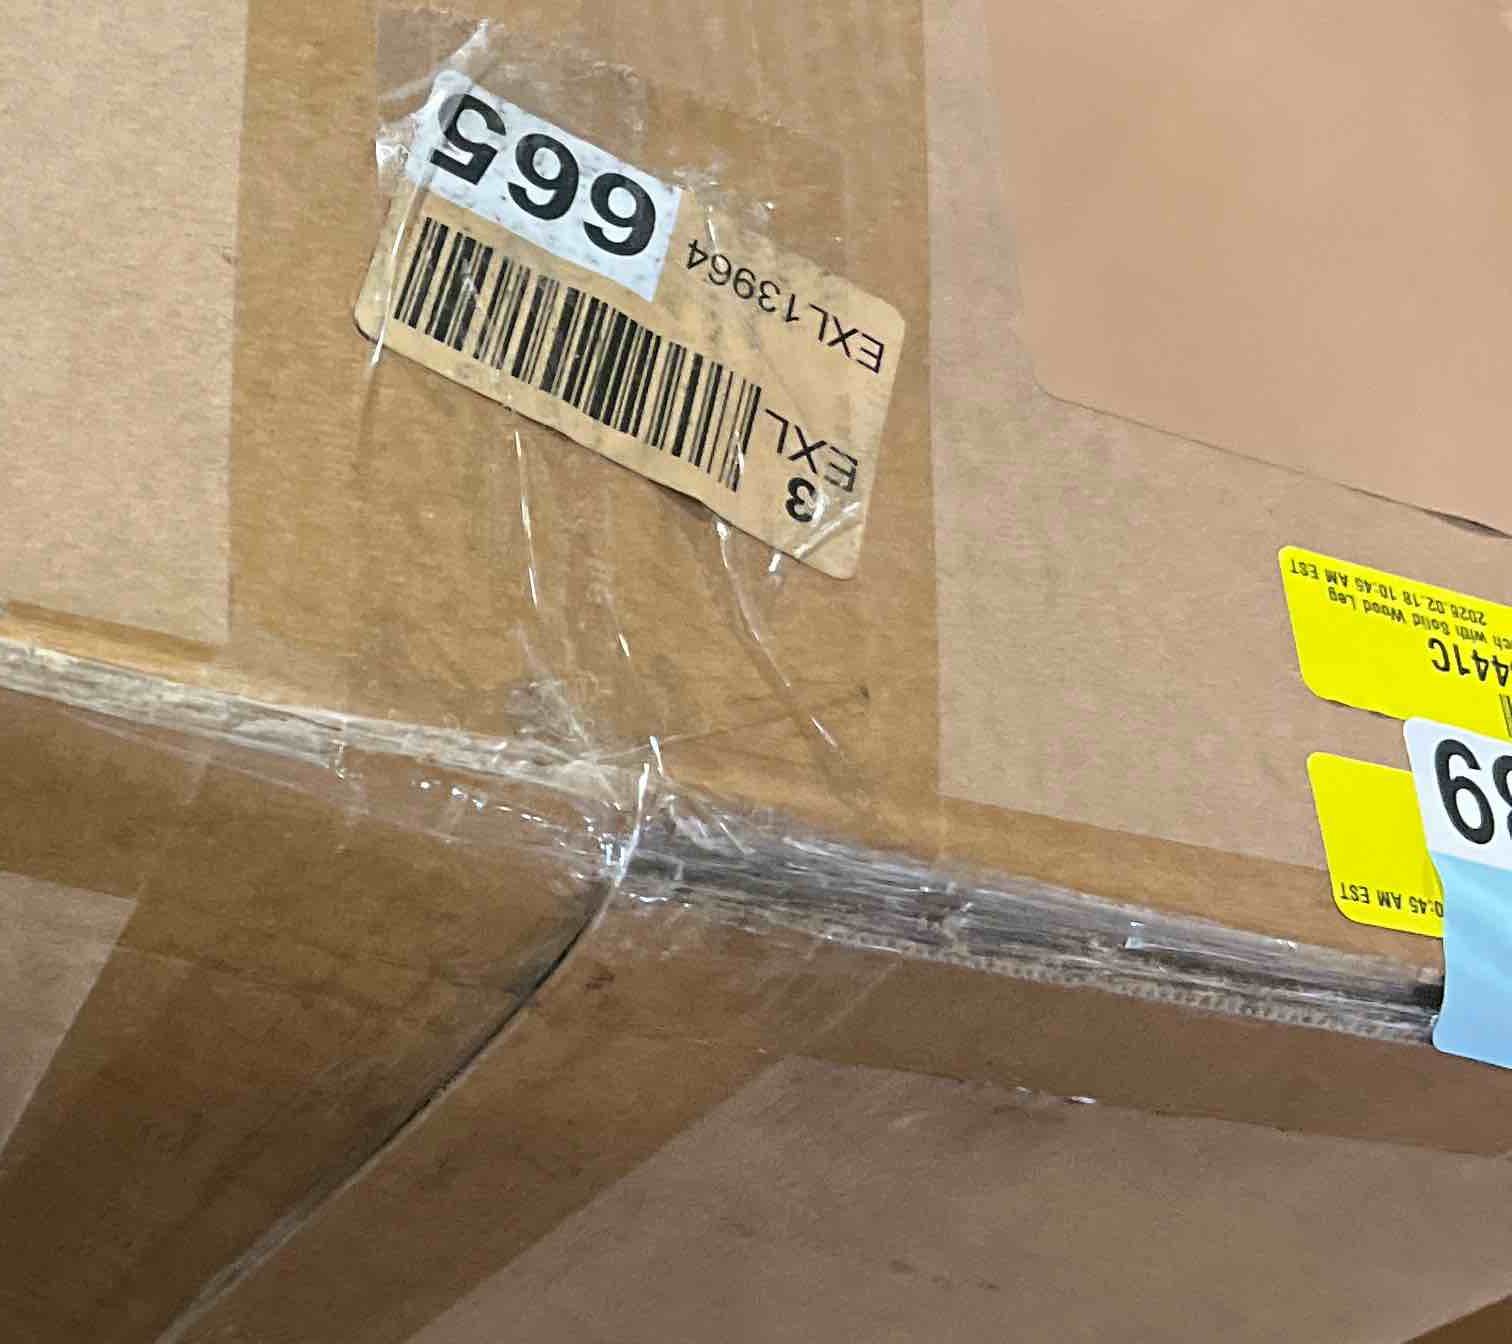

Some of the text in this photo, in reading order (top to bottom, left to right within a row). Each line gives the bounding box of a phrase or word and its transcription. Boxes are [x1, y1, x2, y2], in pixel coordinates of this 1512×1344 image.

[430, 93, 657, 256] 665
[686, 239, 885, 374] EXL13964
[765, 407, 859, 493] EXL
[784, 476, 819, 523] 3
[1290, 558, 1319, 580] EST
[1324, 568, 1349, 587] AM
[1328, 586, 1357, 612] Leg
[1354, 577, 1397, 601] 10:45
[1362, 598, 1408, 625] Wood
[1412, 612, 1451, 636] Solid
[1455, 624, 1487, 644] with
[1428, 637, 1512, 687] 441C
[1339, 881, 1370, 904] EST
[1376, 888, 1403, 910] AM
